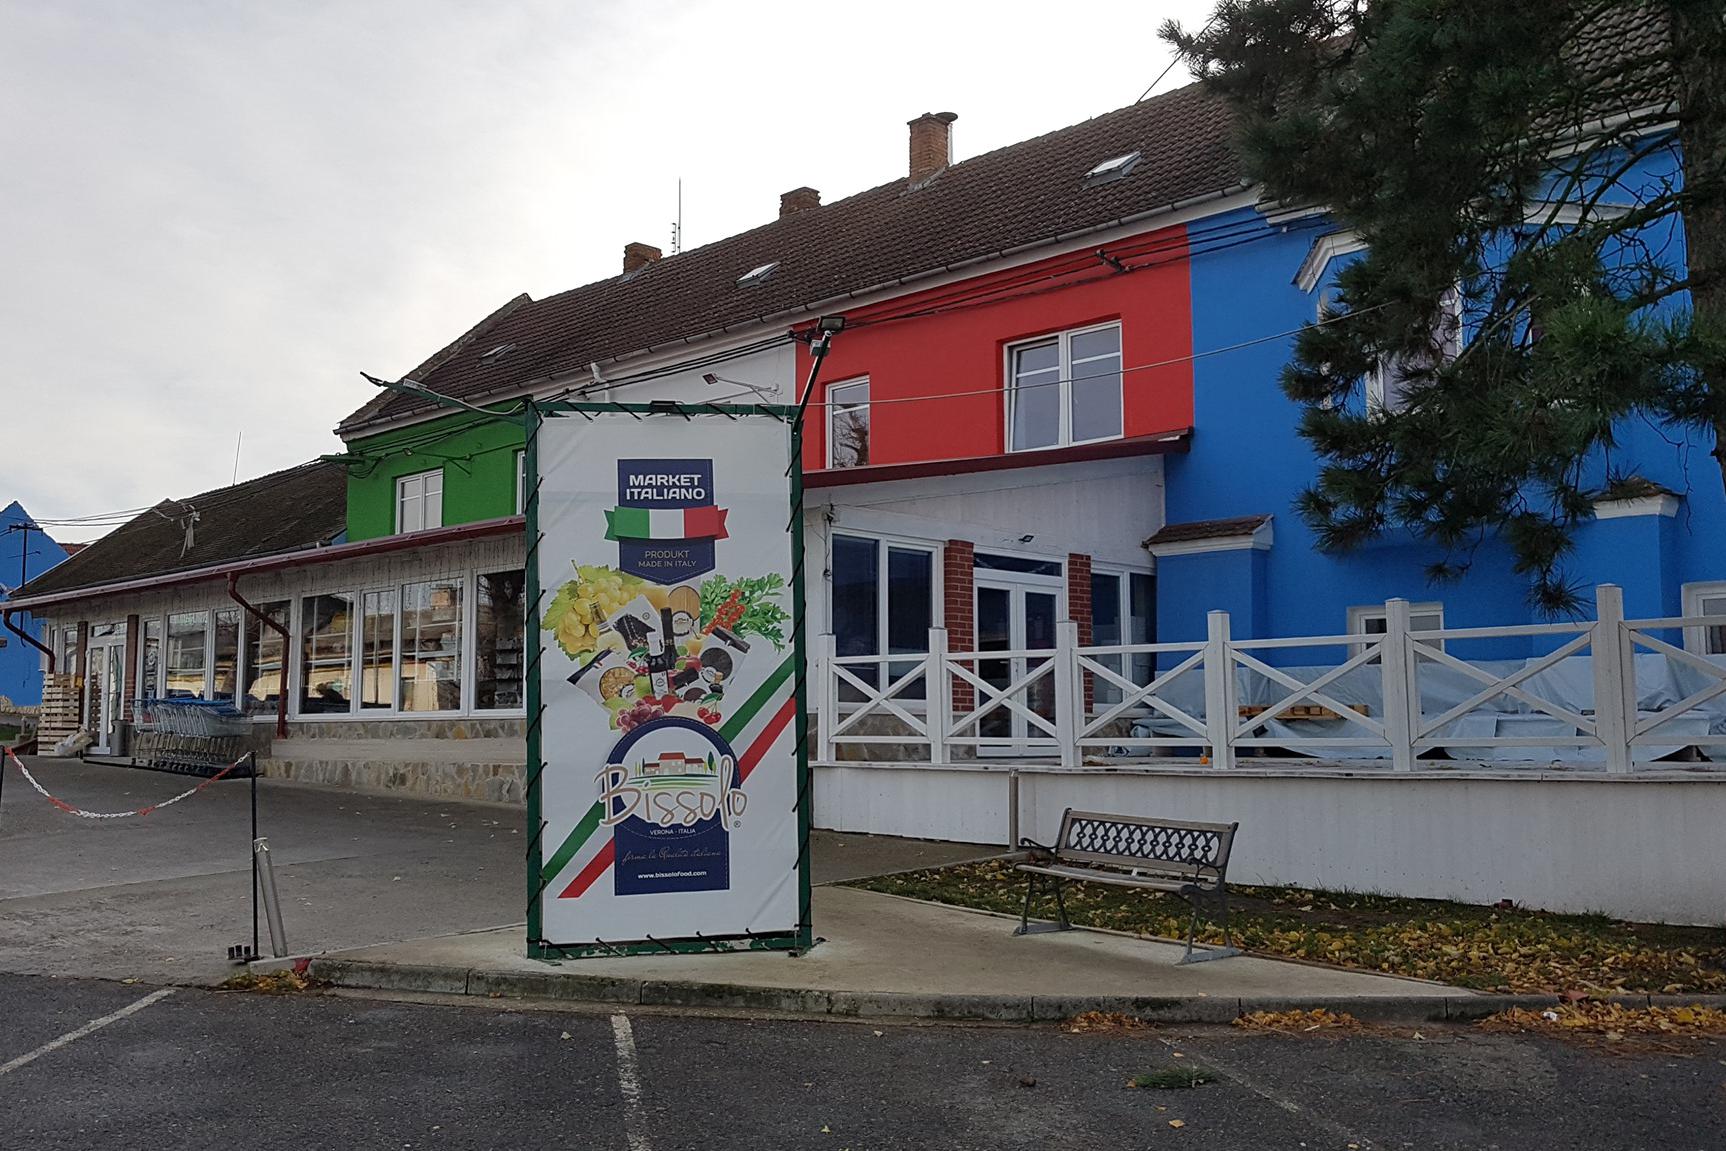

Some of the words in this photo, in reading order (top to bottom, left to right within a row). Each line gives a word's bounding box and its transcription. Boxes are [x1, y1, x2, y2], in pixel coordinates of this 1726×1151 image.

[629, 474, 702, 487] MARKET
[626, 488, 706, 500] ITALIANO
[644, 550, 690, 559] PRODUKT
[638, 560, 662, 568] MADE
[664, 560, 673, 568] IN
[675, 560, 697, 568] ITALY
[593, 757, 748, 829] Bissolo
[638, 871, 707, 880] www.bissolofood.com
